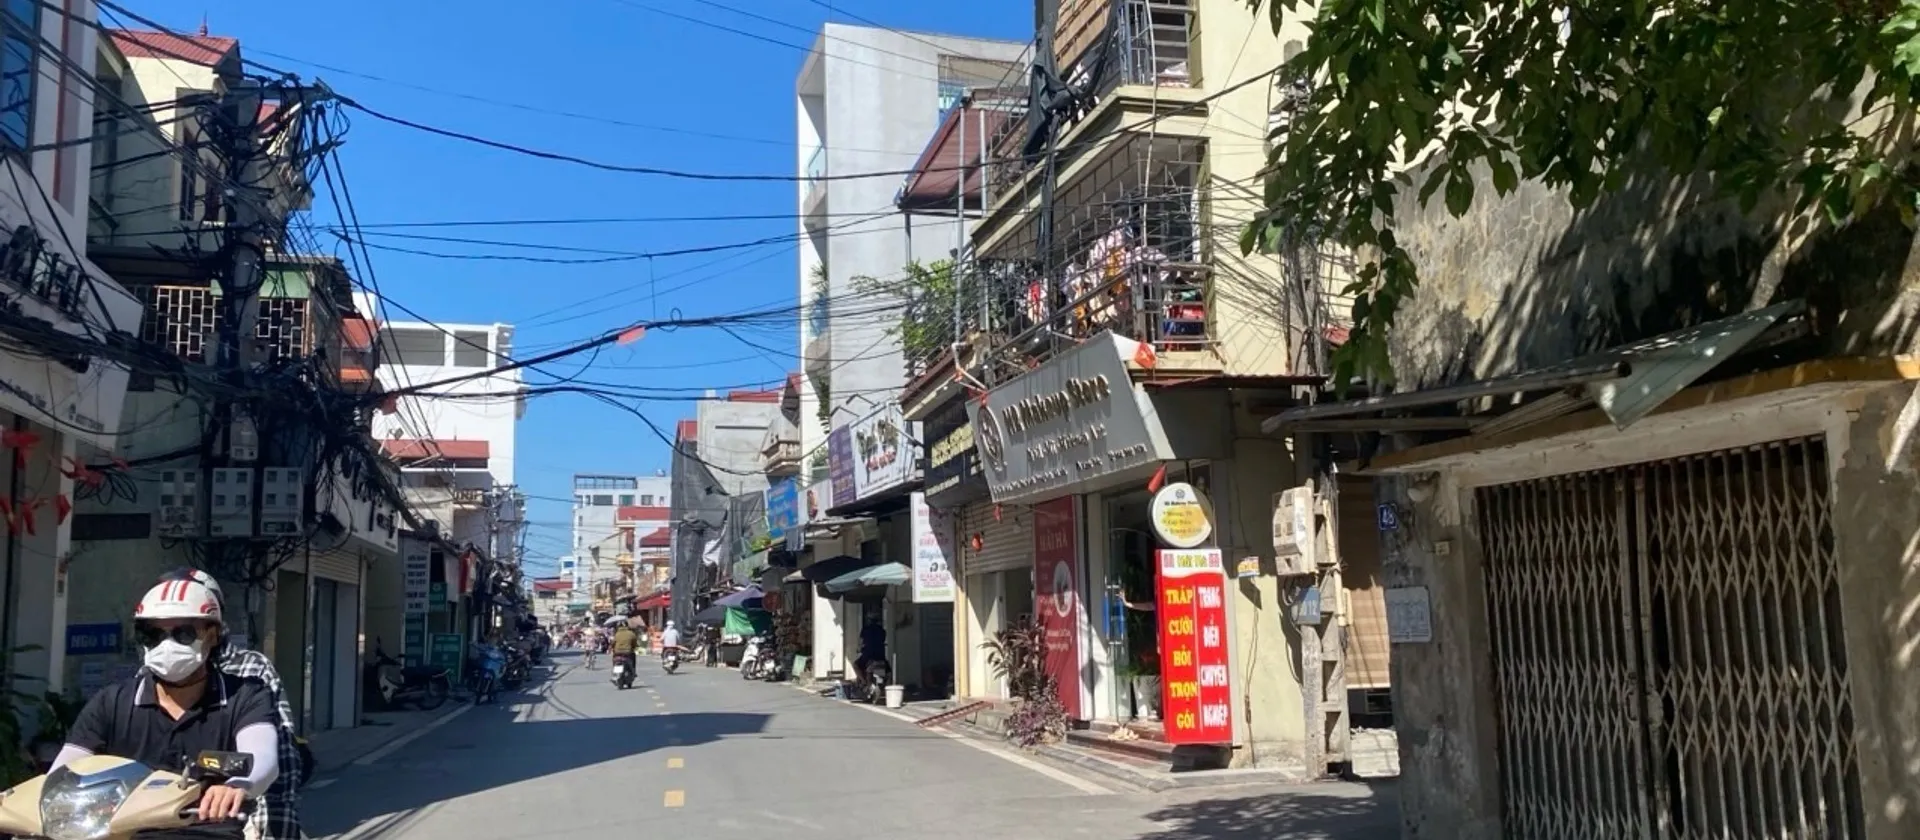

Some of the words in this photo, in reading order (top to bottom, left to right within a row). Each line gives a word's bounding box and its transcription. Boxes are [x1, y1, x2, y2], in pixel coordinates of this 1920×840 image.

[1019, 390, 1071, 429] Makeup
[1066, 374, 1112, 409] Store
[1169, 681, 1198, 702] TRỌN
[1176, 707, 1195, 729] GÓI
